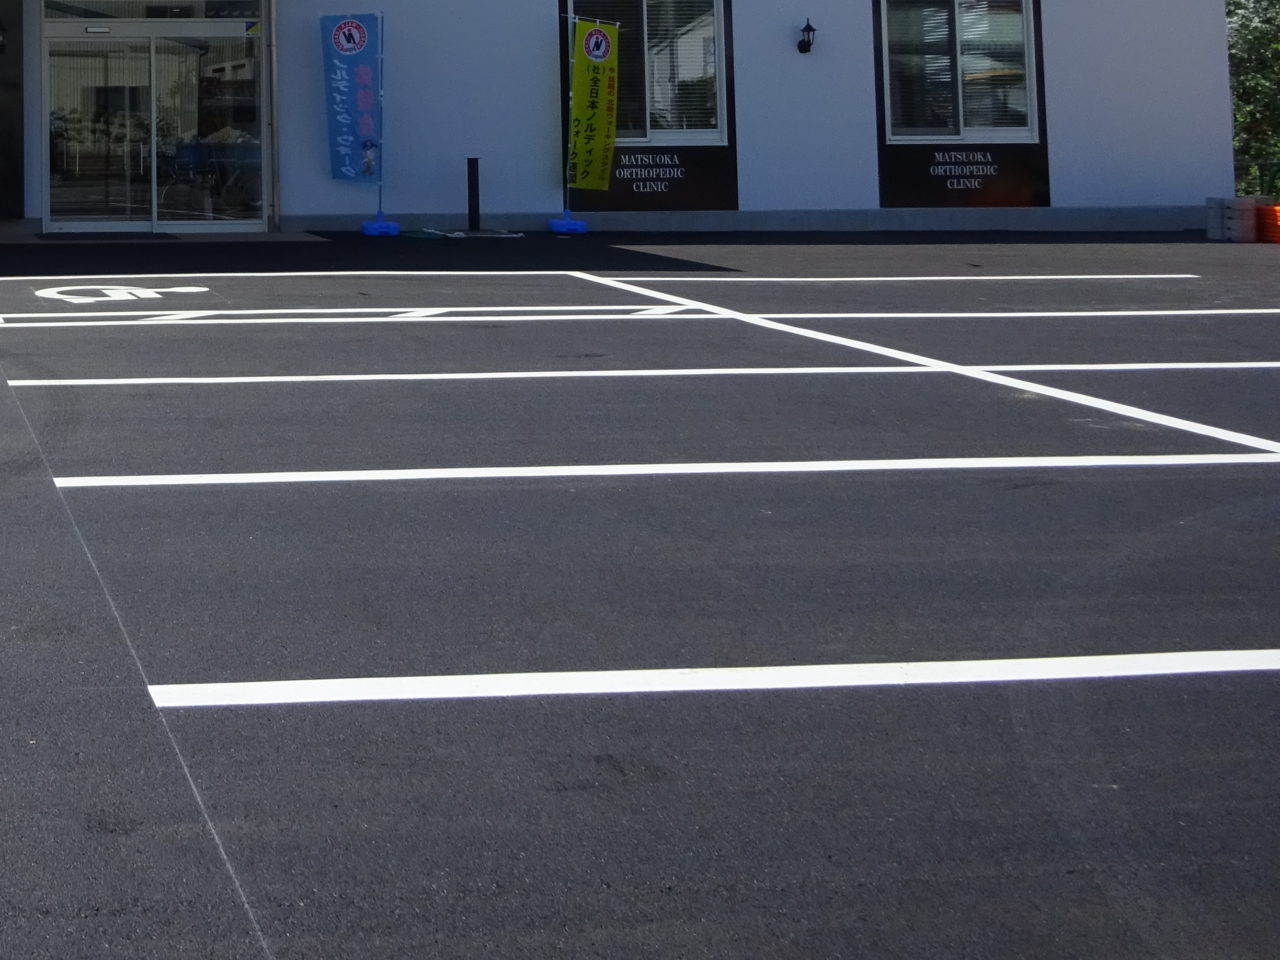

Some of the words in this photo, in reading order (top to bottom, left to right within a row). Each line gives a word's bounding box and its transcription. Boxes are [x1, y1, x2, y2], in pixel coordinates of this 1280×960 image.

[620, 154, 680, 165] MATSUOKA
[934, 151, 992, 162] MATSUOKA
[615, 167, 686, 179] ORTHOPEDIC
[930, 165, 999, 176] ORTHOPEDIC
[632, 181, 669, 192] CLINIC
[946, 178, 983, 189] CLINIC
